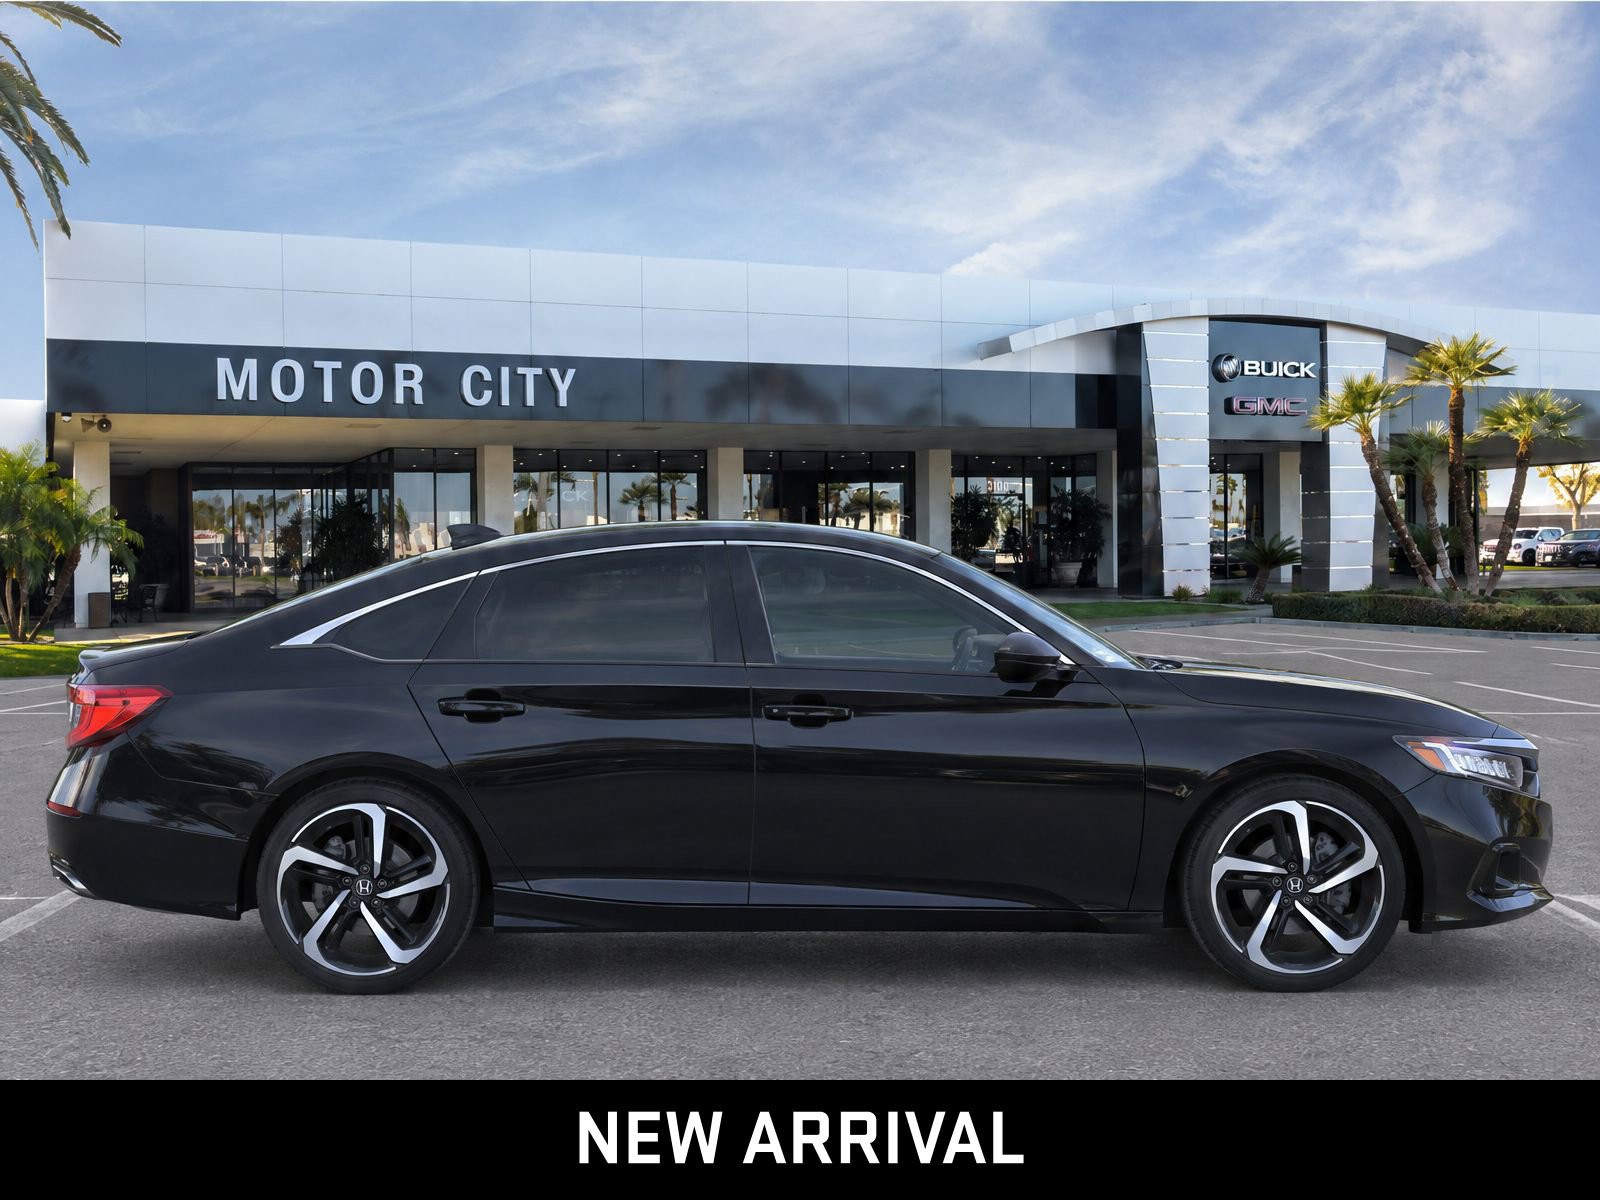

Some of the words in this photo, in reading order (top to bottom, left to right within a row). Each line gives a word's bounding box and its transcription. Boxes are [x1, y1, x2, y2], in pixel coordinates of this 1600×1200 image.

[1243, 360, 1317, 378] BUICK
[217, 357, 424, 405] MOTOR
[460, 364, 576, 407] CITY
[1233, 396, 1308, 415] GMC
